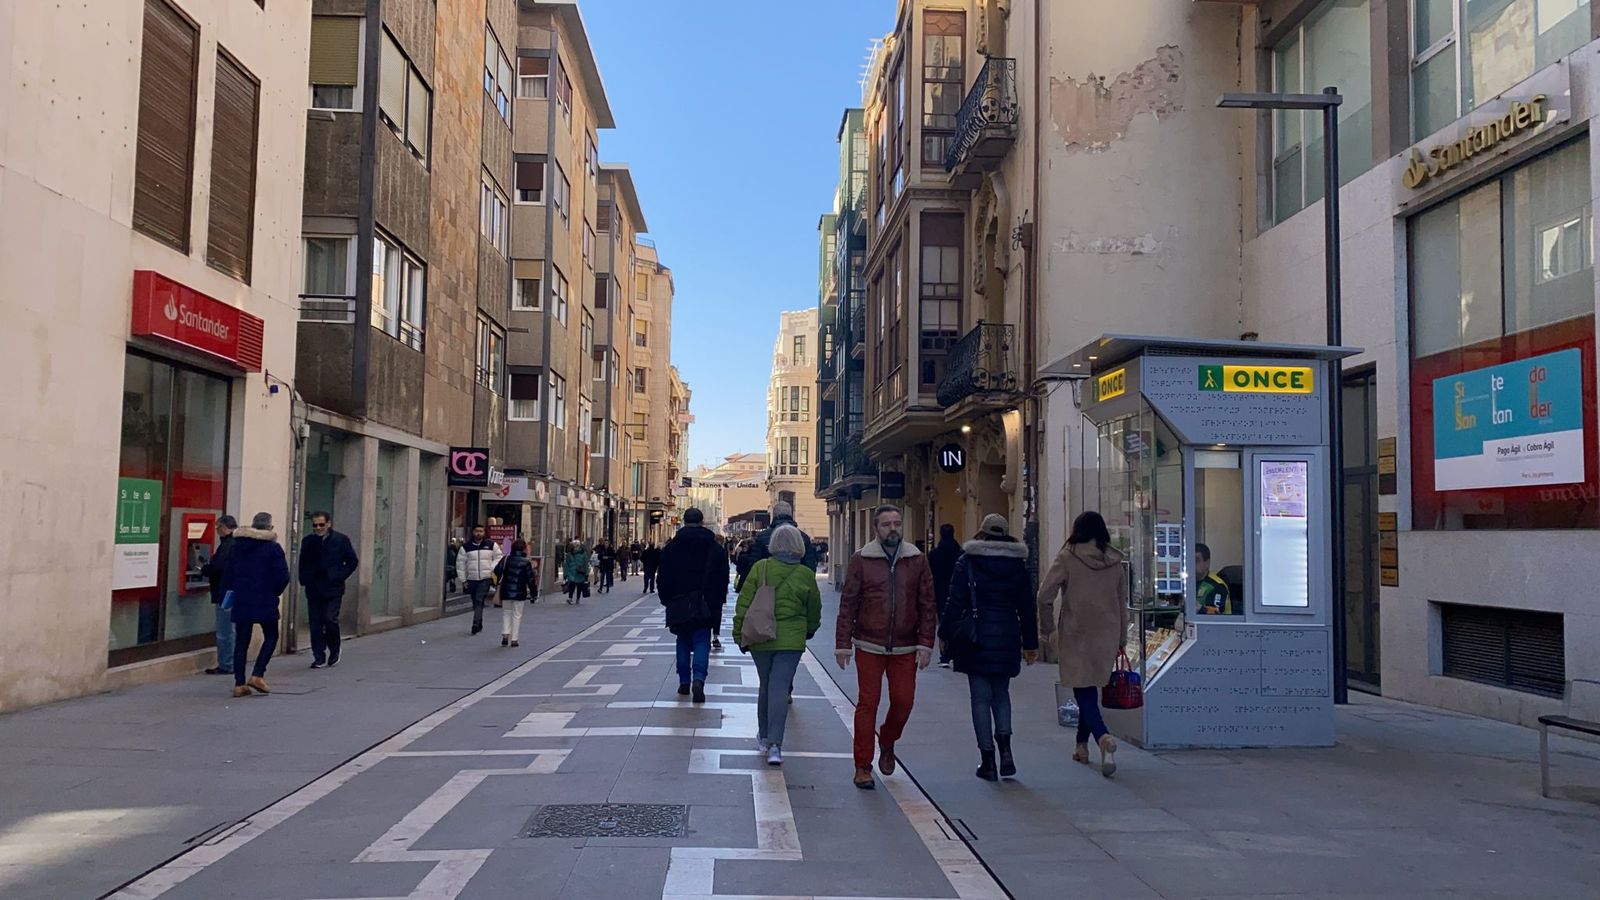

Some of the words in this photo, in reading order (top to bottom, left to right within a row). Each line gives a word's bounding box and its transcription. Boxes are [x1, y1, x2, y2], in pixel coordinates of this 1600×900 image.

[1427, 94, 1546, 178] Santander
[179, 304, 230, 339] Santander
[1101, 373, 1123, 396] ONCE
[1233, 370, 1305, 389] ONCE
[1455, 381, 1465, 399] Si
[1491, 374, 1504, 391] te
[1455, 410, 1477, 431] San
[1493, 405, 1512, 425] tan
[1530, 401, 1552, 418] der
[943, 450, 962, 466] IN
[1497, 446, 1510, 456] Pago
[1526, 443, 1543, 452] Cobro
